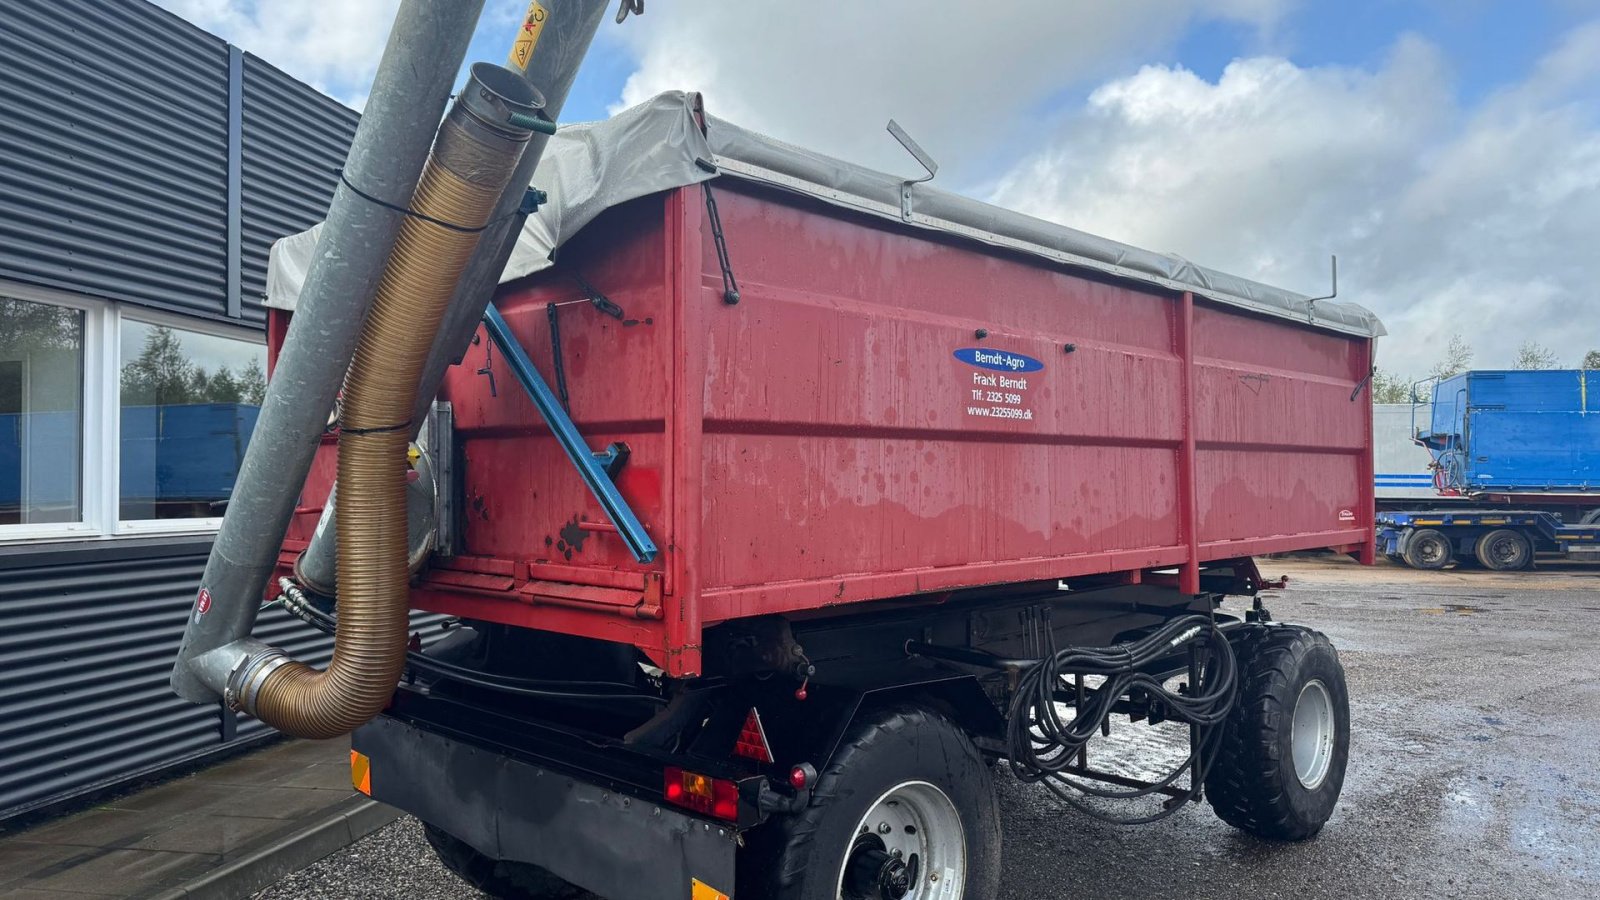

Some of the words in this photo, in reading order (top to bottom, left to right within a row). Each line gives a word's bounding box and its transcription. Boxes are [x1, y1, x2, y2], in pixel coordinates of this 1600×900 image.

[975, 350, 1025, 370] Berndt-Agro
[973, 372, 997, 387] Frank
[1000, 375, 1027, 390] Berndt
[972, 389, 984, 401] Tlf.
[987, 391, 1003, 403] 2325
[1005, 393, 1021, 404] 5099
[967, 406, 1033, 420] www.23255099.dk
